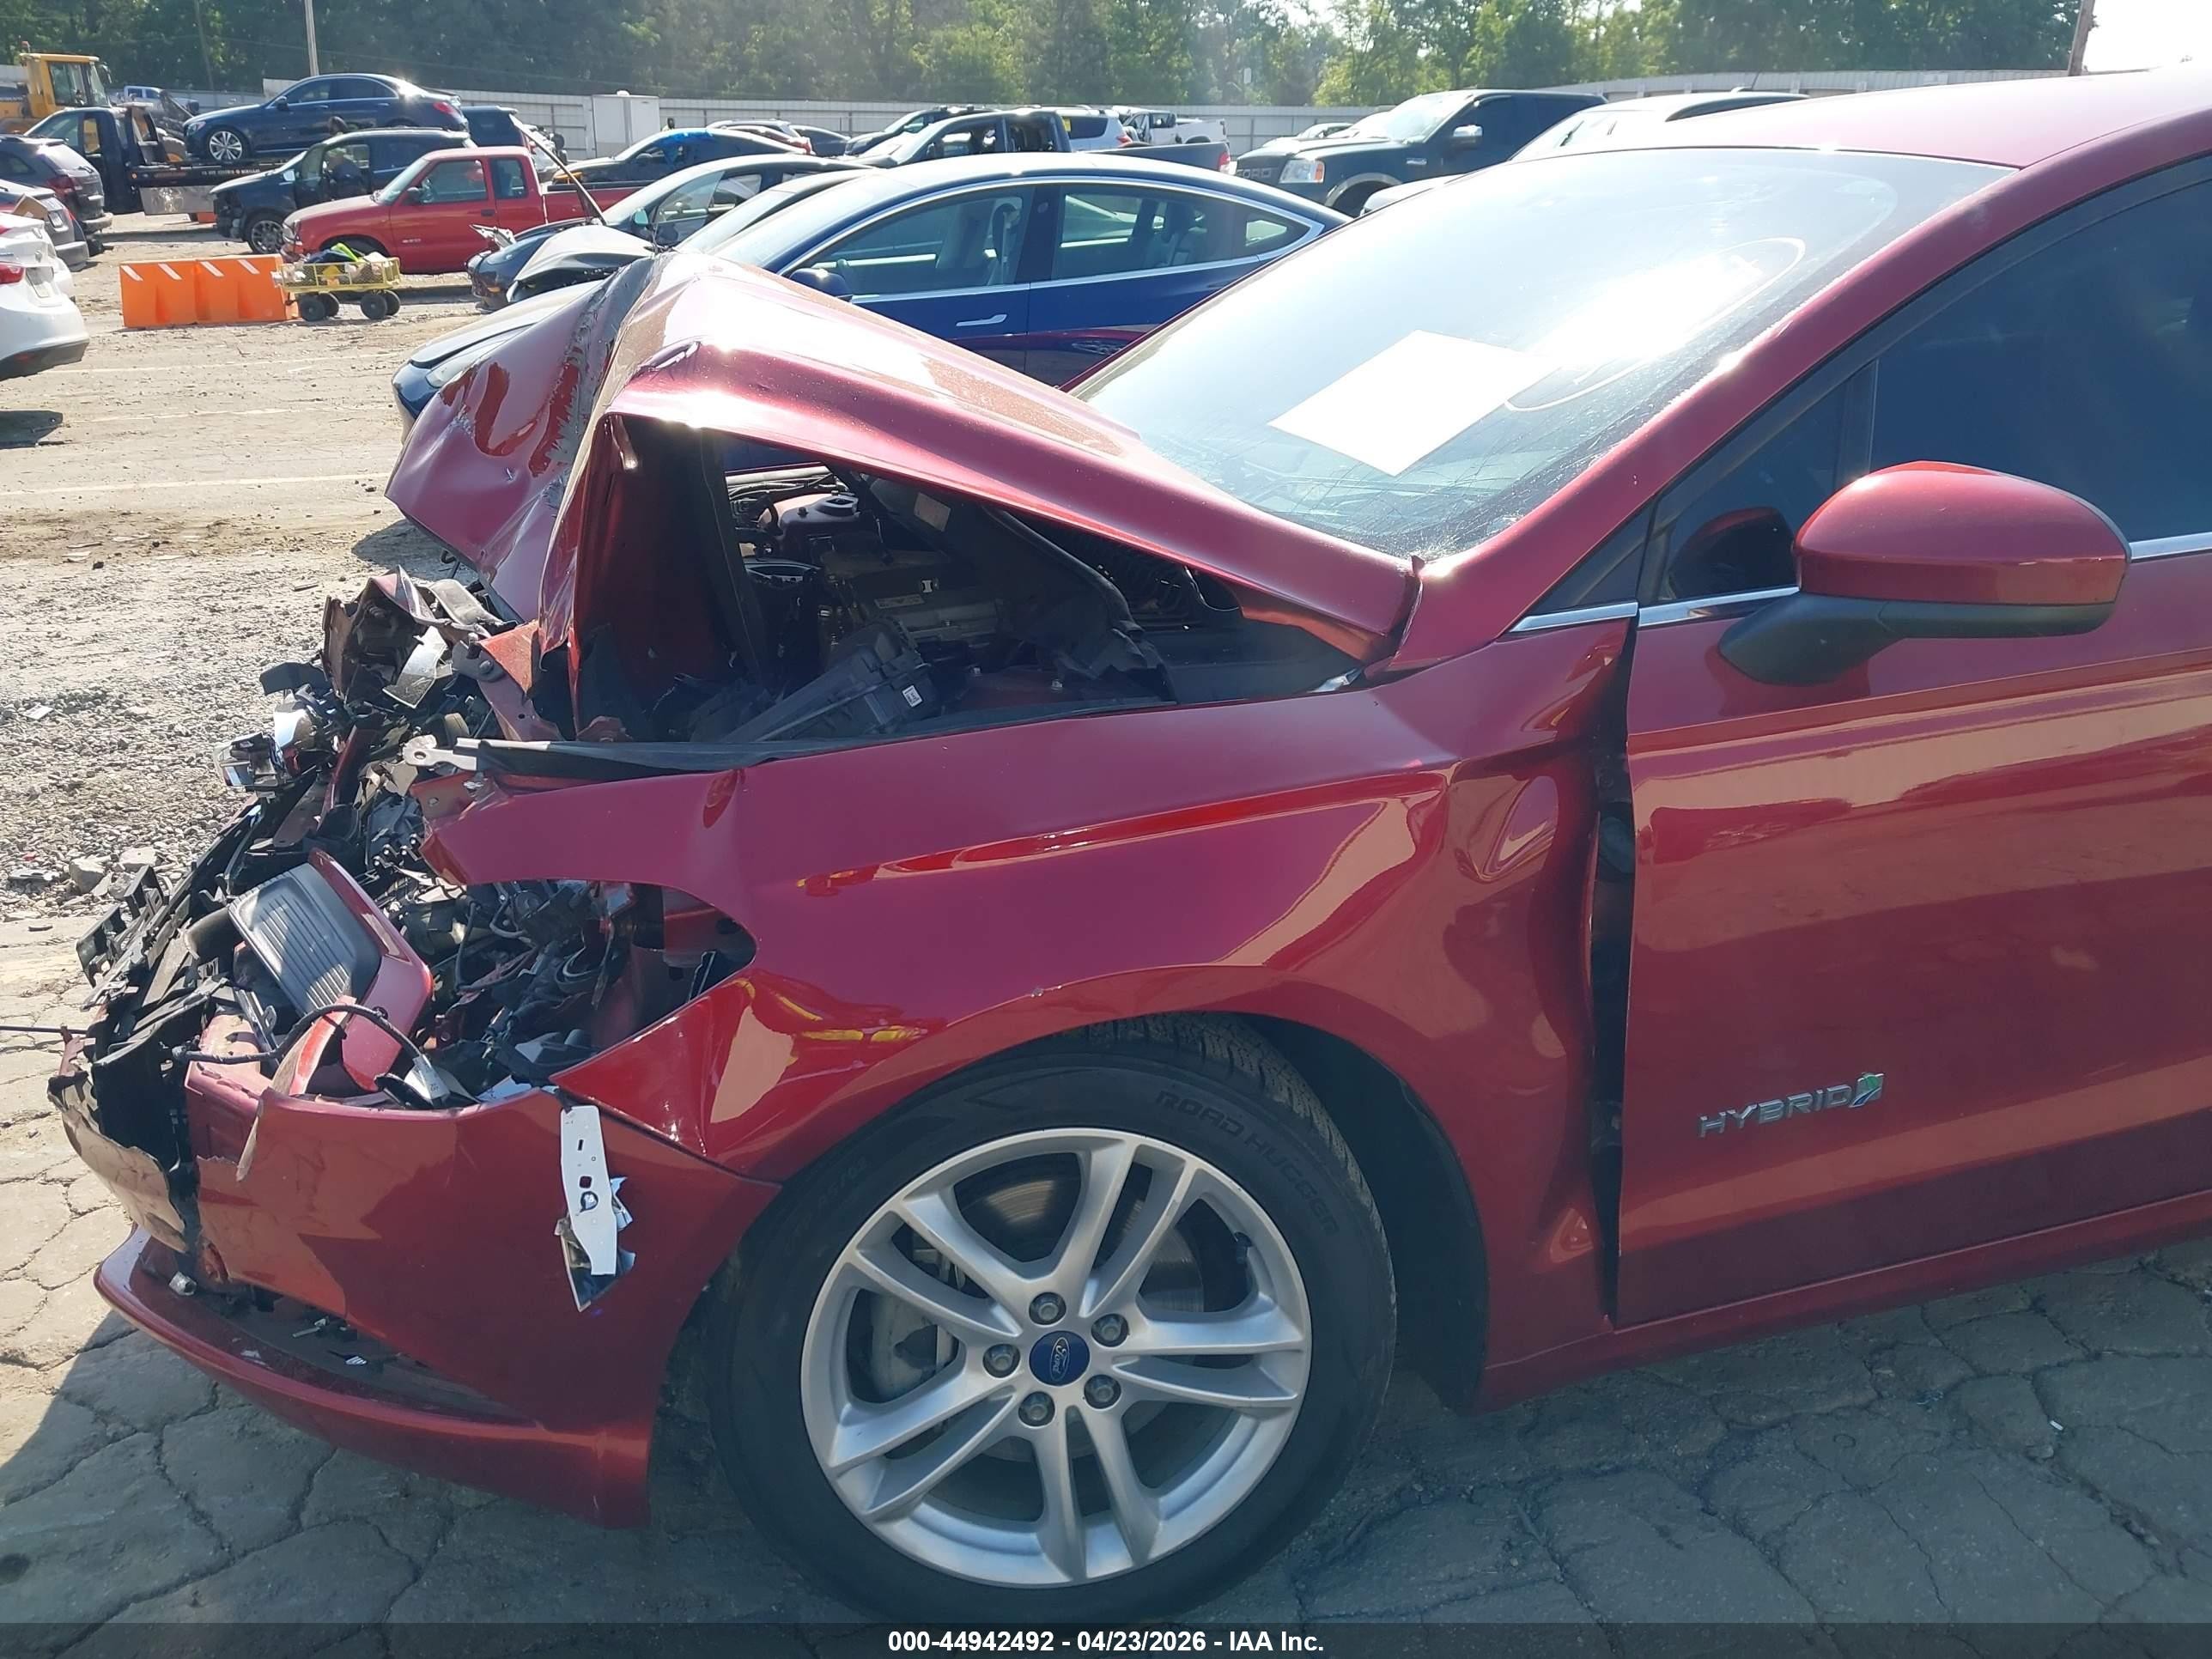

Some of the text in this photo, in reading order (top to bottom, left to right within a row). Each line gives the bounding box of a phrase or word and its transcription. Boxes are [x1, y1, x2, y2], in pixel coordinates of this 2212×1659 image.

[1699, 1085, 1852, 1138] HYBRID
[1155, 1090, 1340, 1235] ROAD HUGGER
